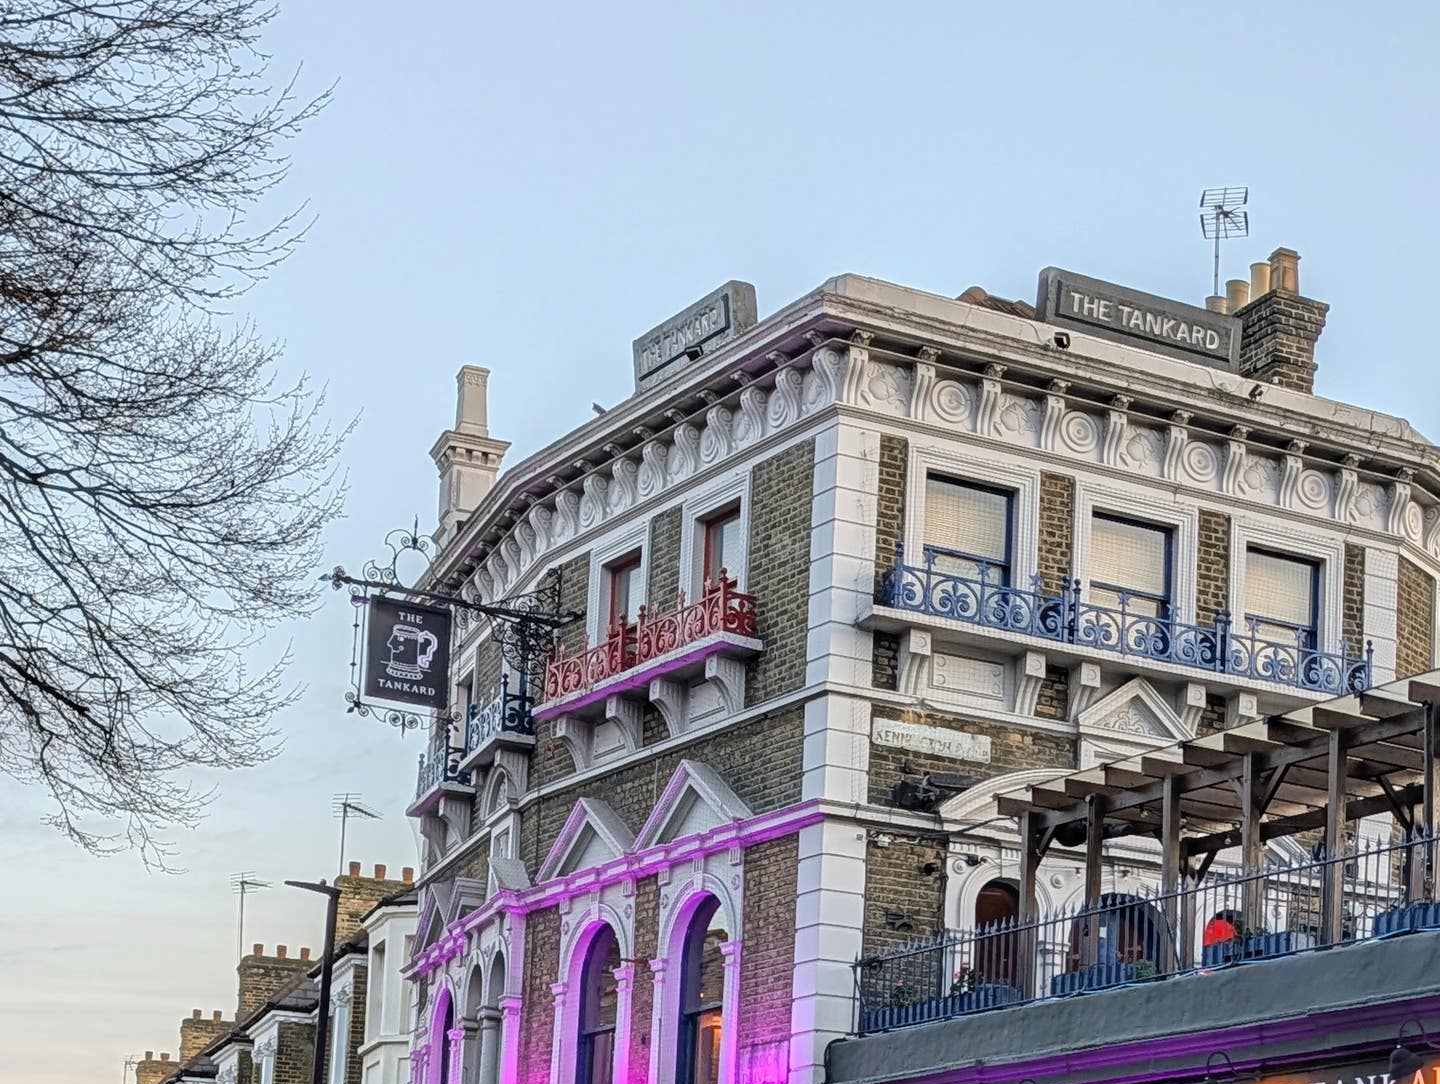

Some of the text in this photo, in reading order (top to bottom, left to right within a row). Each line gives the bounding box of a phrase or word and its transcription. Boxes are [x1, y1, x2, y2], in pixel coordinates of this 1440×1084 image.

[1070, 291, 1220, 350] THE TANKARD
[398, 611, 423, 624] THE
[377, 678, 436, 696] TANKARD
